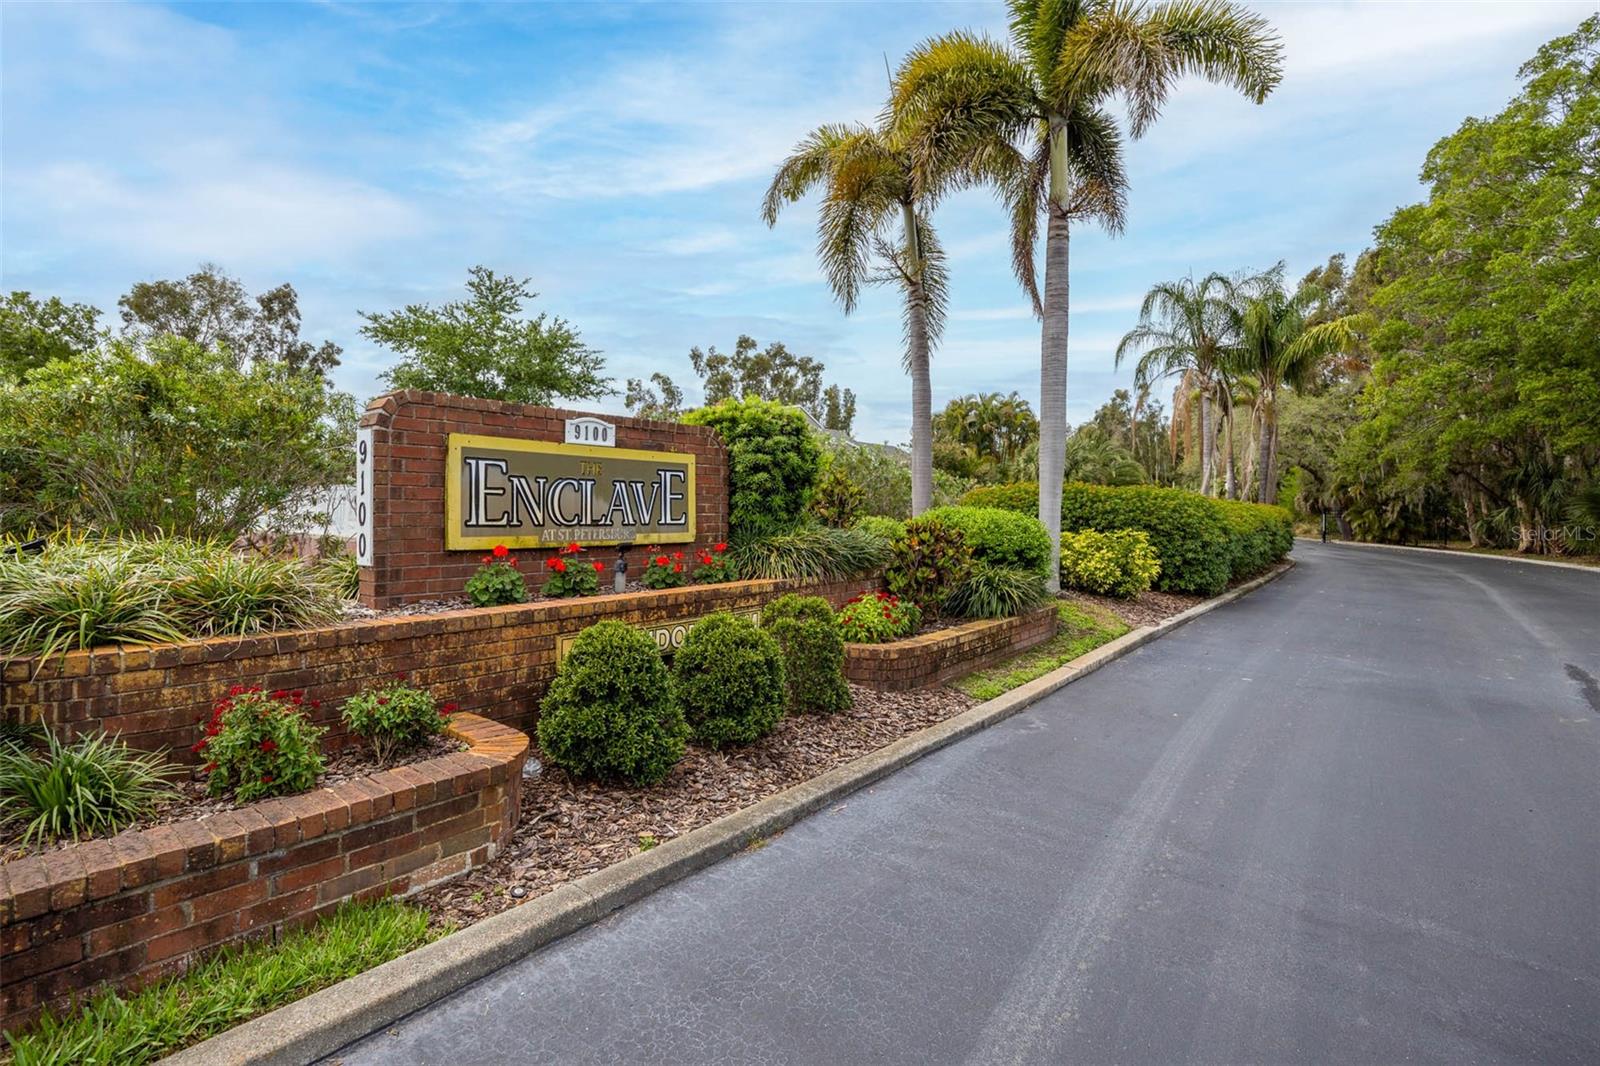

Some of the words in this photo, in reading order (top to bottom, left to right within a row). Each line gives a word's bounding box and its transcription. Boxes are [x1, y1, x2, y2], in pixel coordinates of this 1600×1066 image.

[574, 424, 608, 442] 9100
[579, 460, 603, 476] THE
[358, 439, 367, 557] 9100
[465, 457, 687, 527] ENCLAVE
[542, 529, 556, 542] AT
